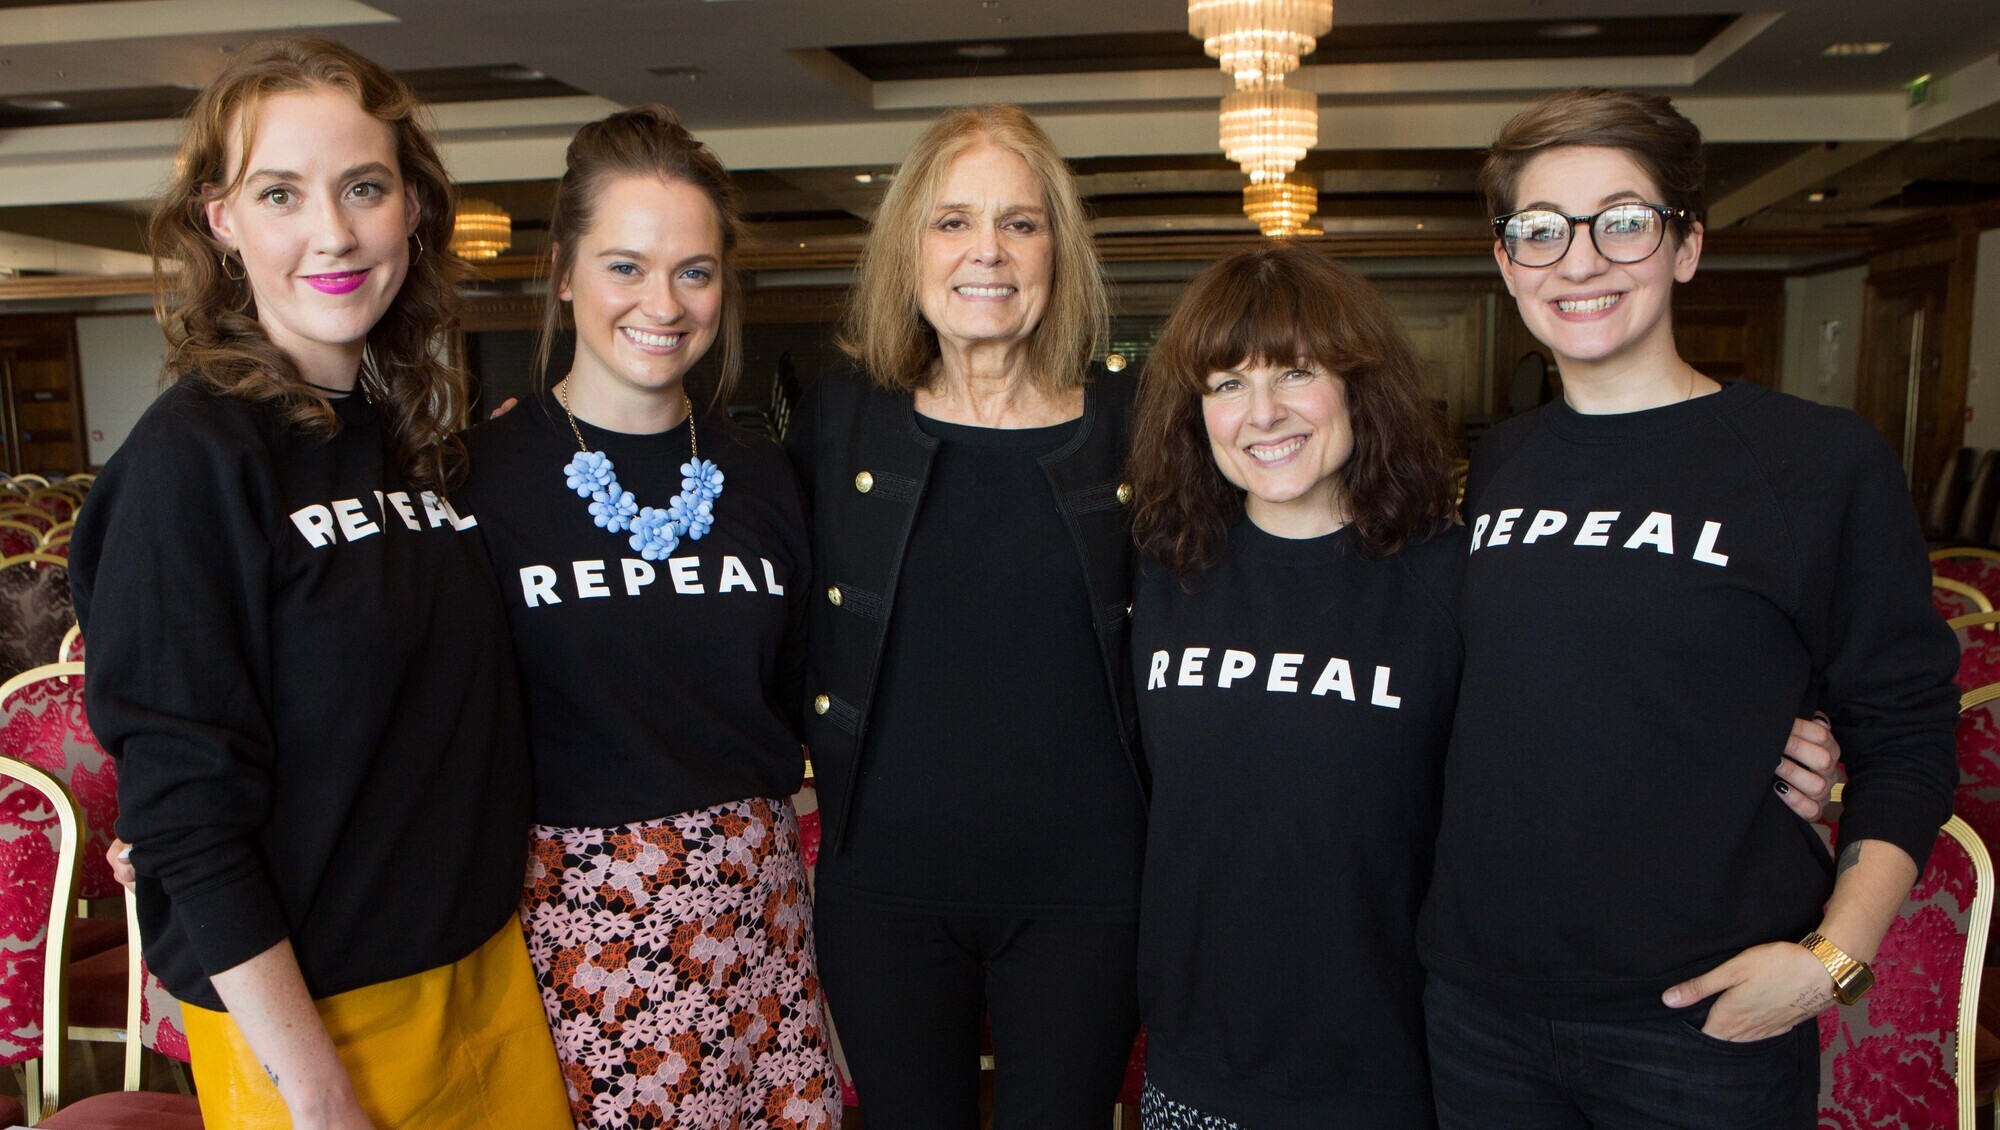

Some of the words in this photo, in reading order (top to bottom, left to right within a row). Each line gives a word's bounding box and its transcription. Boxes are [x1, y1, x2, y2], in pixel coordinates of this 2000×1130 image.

[289, 490, 478, 549] REEAL
[1469, 508, 1730, 567] REPEAL
[519, 556, 784, 608] REPEAL
[1147, 647, 1403, 709] REPEAL
